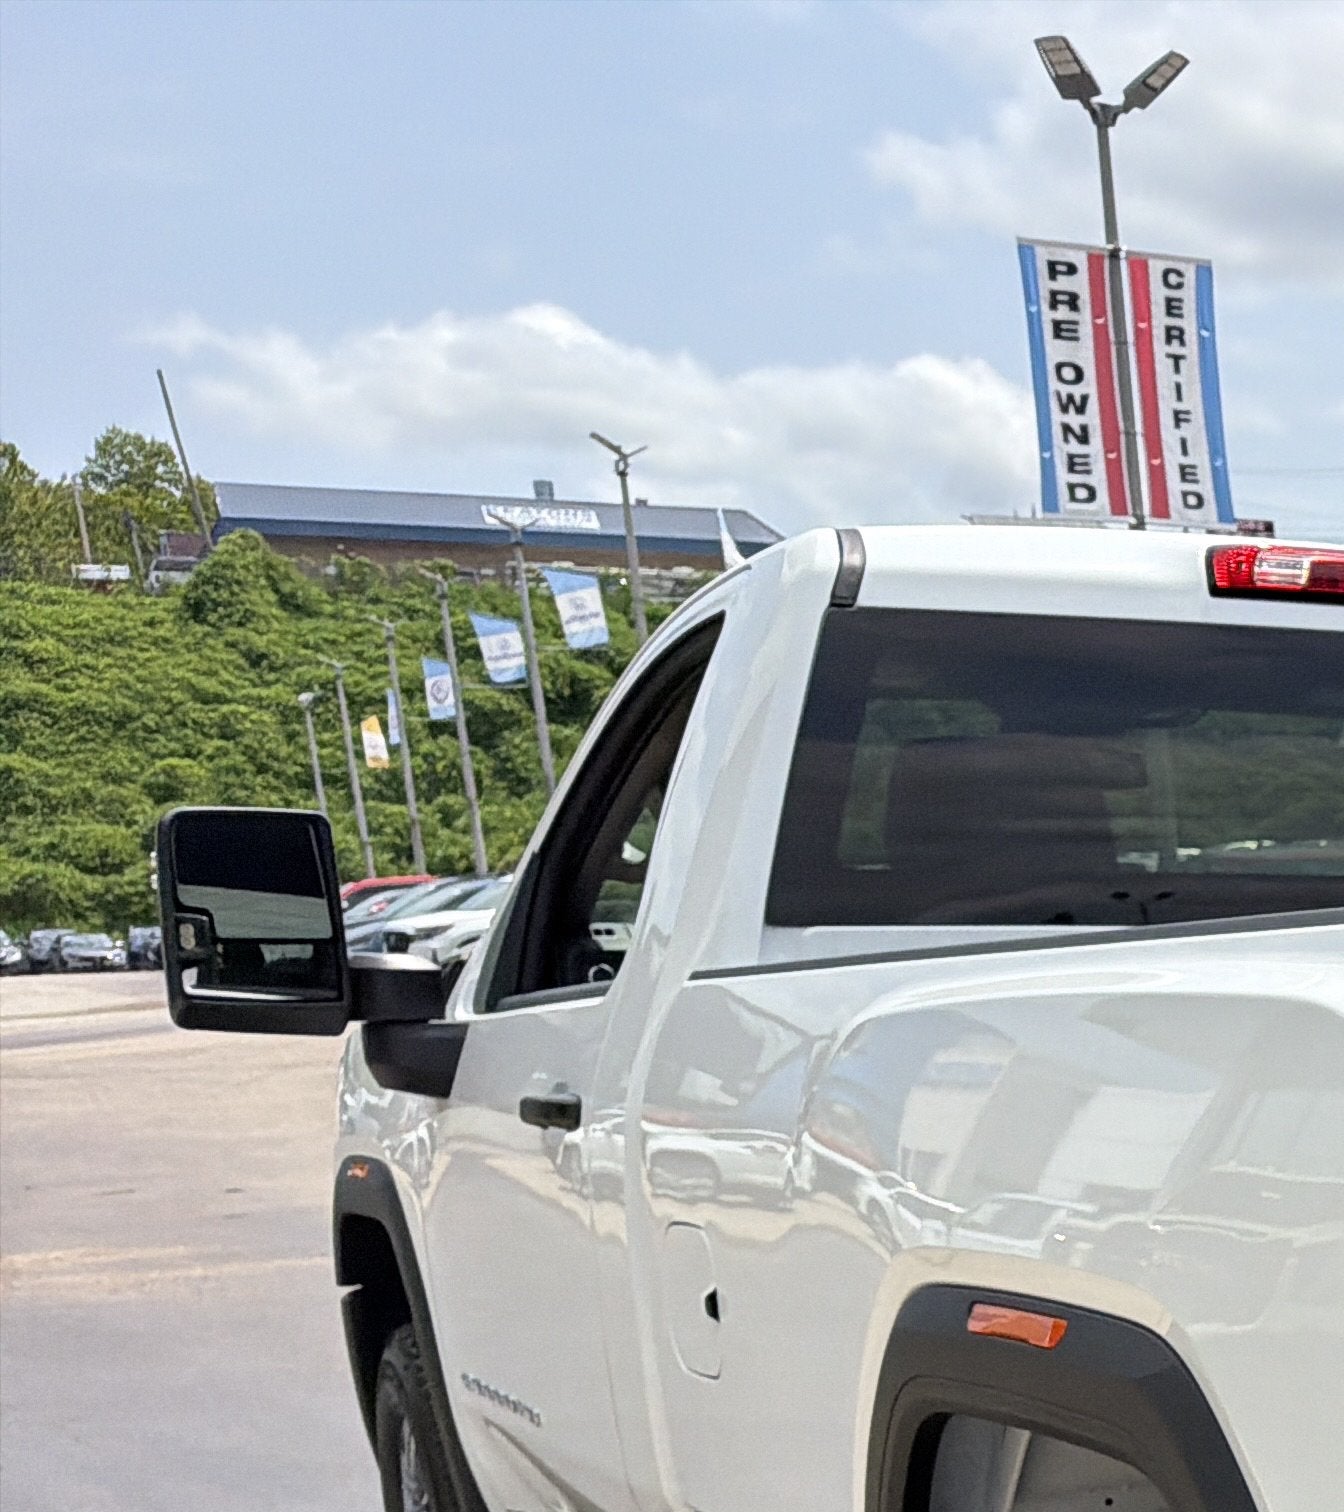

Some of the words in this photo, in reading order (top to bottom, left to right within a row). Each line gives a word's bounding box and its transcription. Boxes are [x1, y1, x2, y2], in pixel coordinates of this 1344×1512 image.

[1046, 259, 1081, 342] PRE
[1054, 361, 1097, 504] OWNED
[1160, 267, 1205, 511] CERTIFIED
